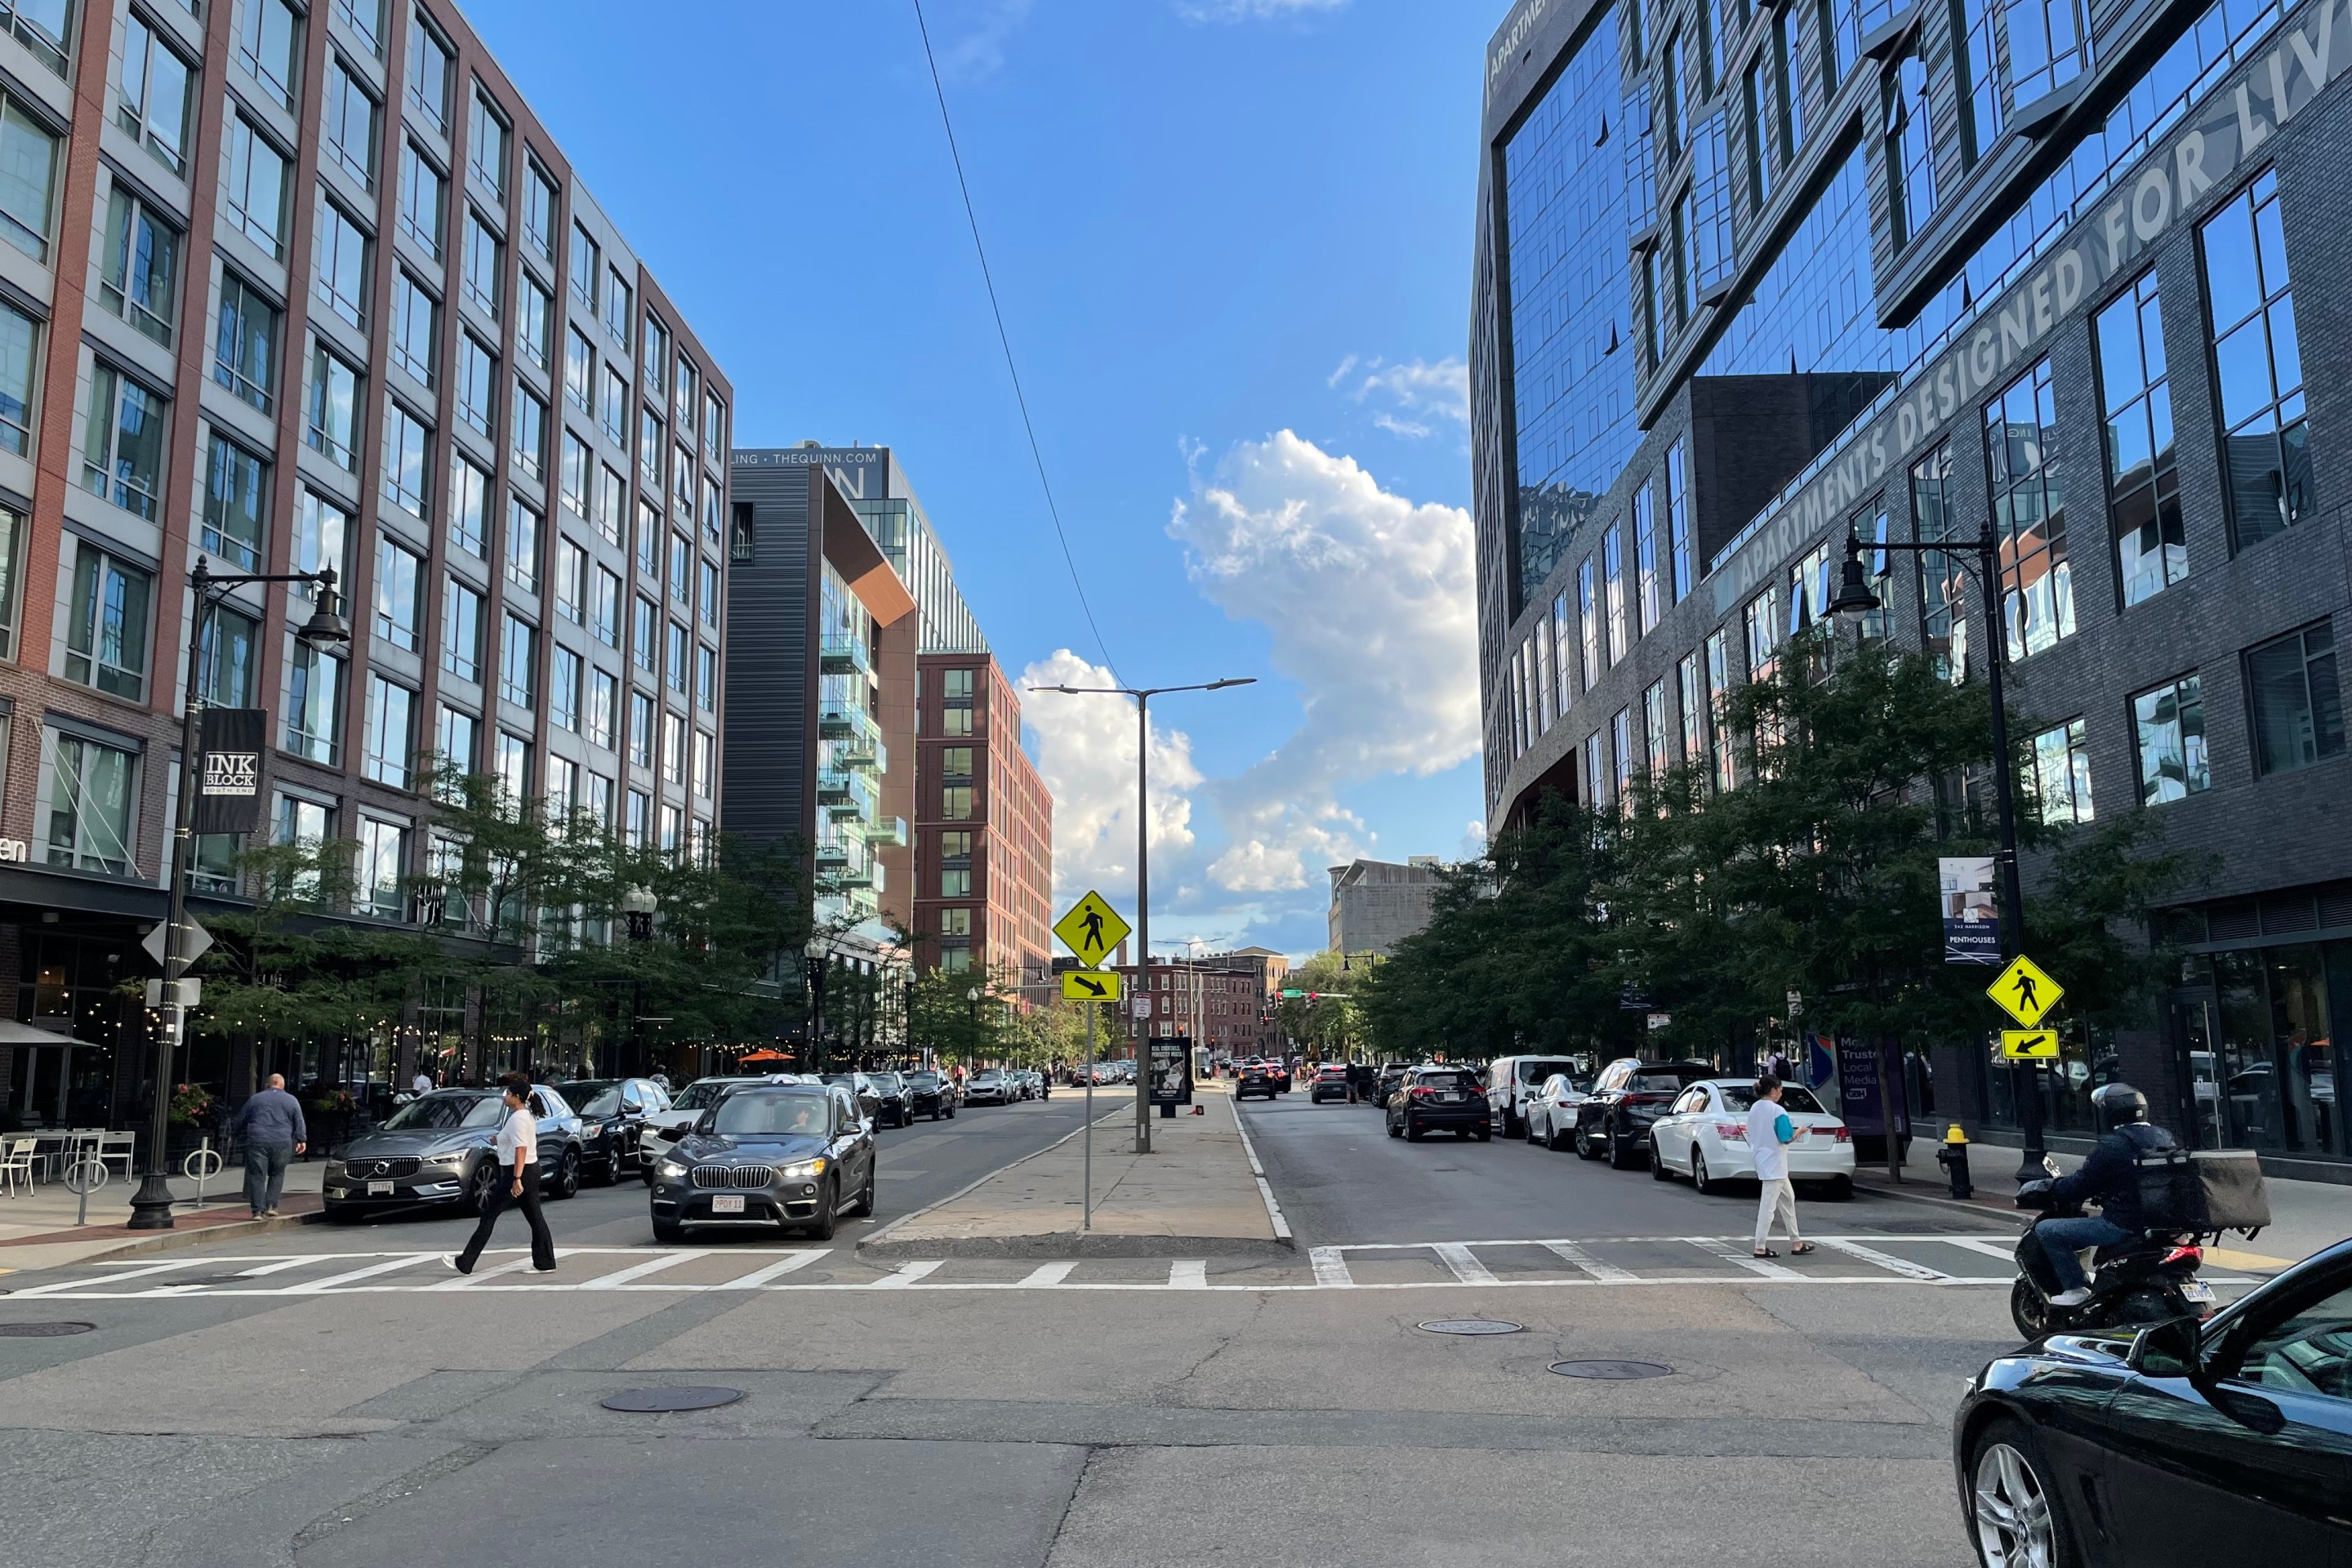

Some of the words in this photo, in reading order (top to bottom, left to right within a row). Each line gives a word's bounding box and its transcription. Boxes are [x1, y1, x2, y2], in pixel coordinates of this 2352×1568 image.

[1740, 427, 1886, 595] APARTMENTS
[1898, 248, 2083, 455] DESIGNED
[2105, 130, 2213, 273] FOR
[773, 453, 876, 464] THEQUINN.COM
[206, 754, 256, 775] INK
[205, 774, 255, 786] BLOCK
[1949, 936, 1996, 944] PENTHOUSES
[1843, 1062, 1872, 1072] Local
[1845, 1075, 1877, 1085] Media
